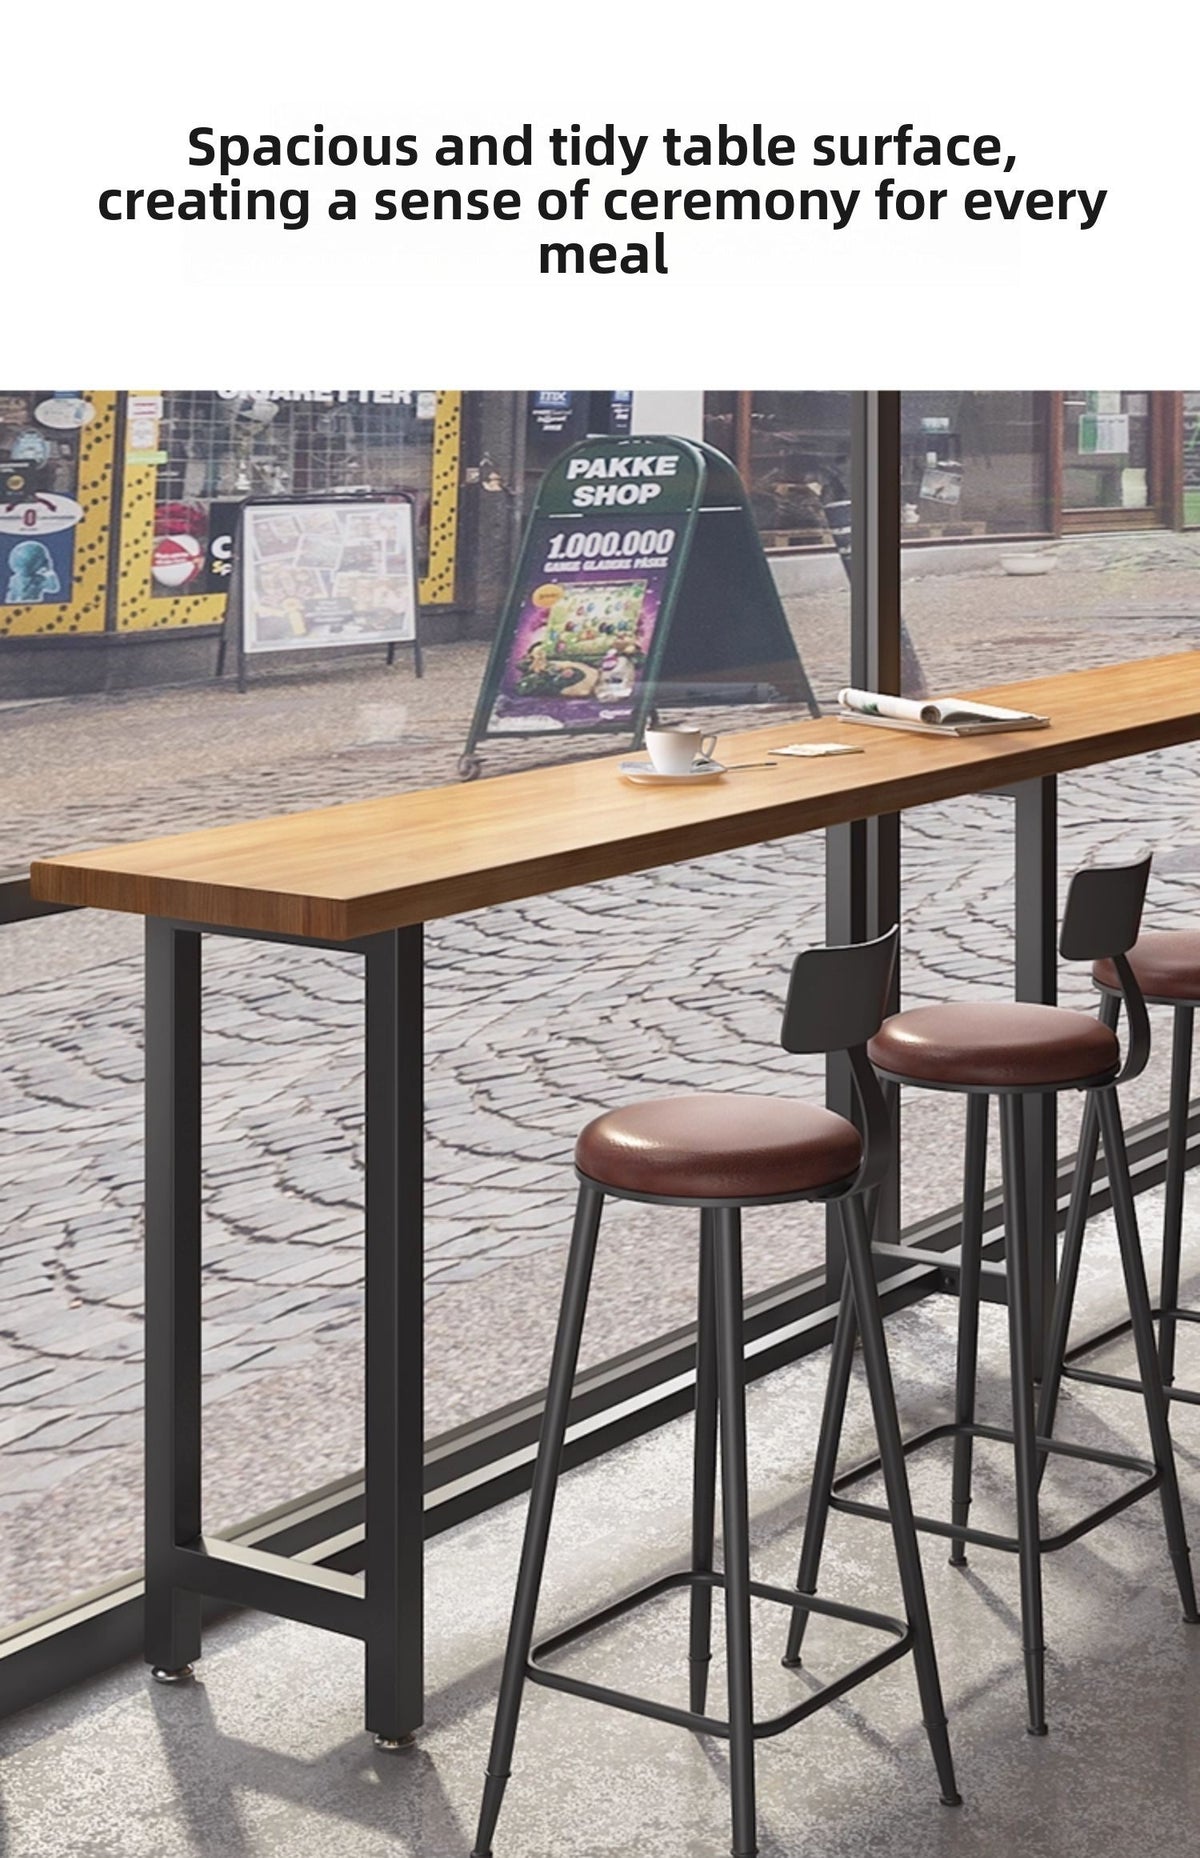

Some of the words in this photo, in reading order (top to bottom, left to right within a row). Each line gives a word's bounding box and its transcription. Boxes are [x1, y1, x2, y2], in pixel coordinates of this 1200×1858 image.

[566, 455, 680, 480] PAKKE
[572, 483, 662, 508] SHOP
[547, 529, 675, 560] 1.000.000
